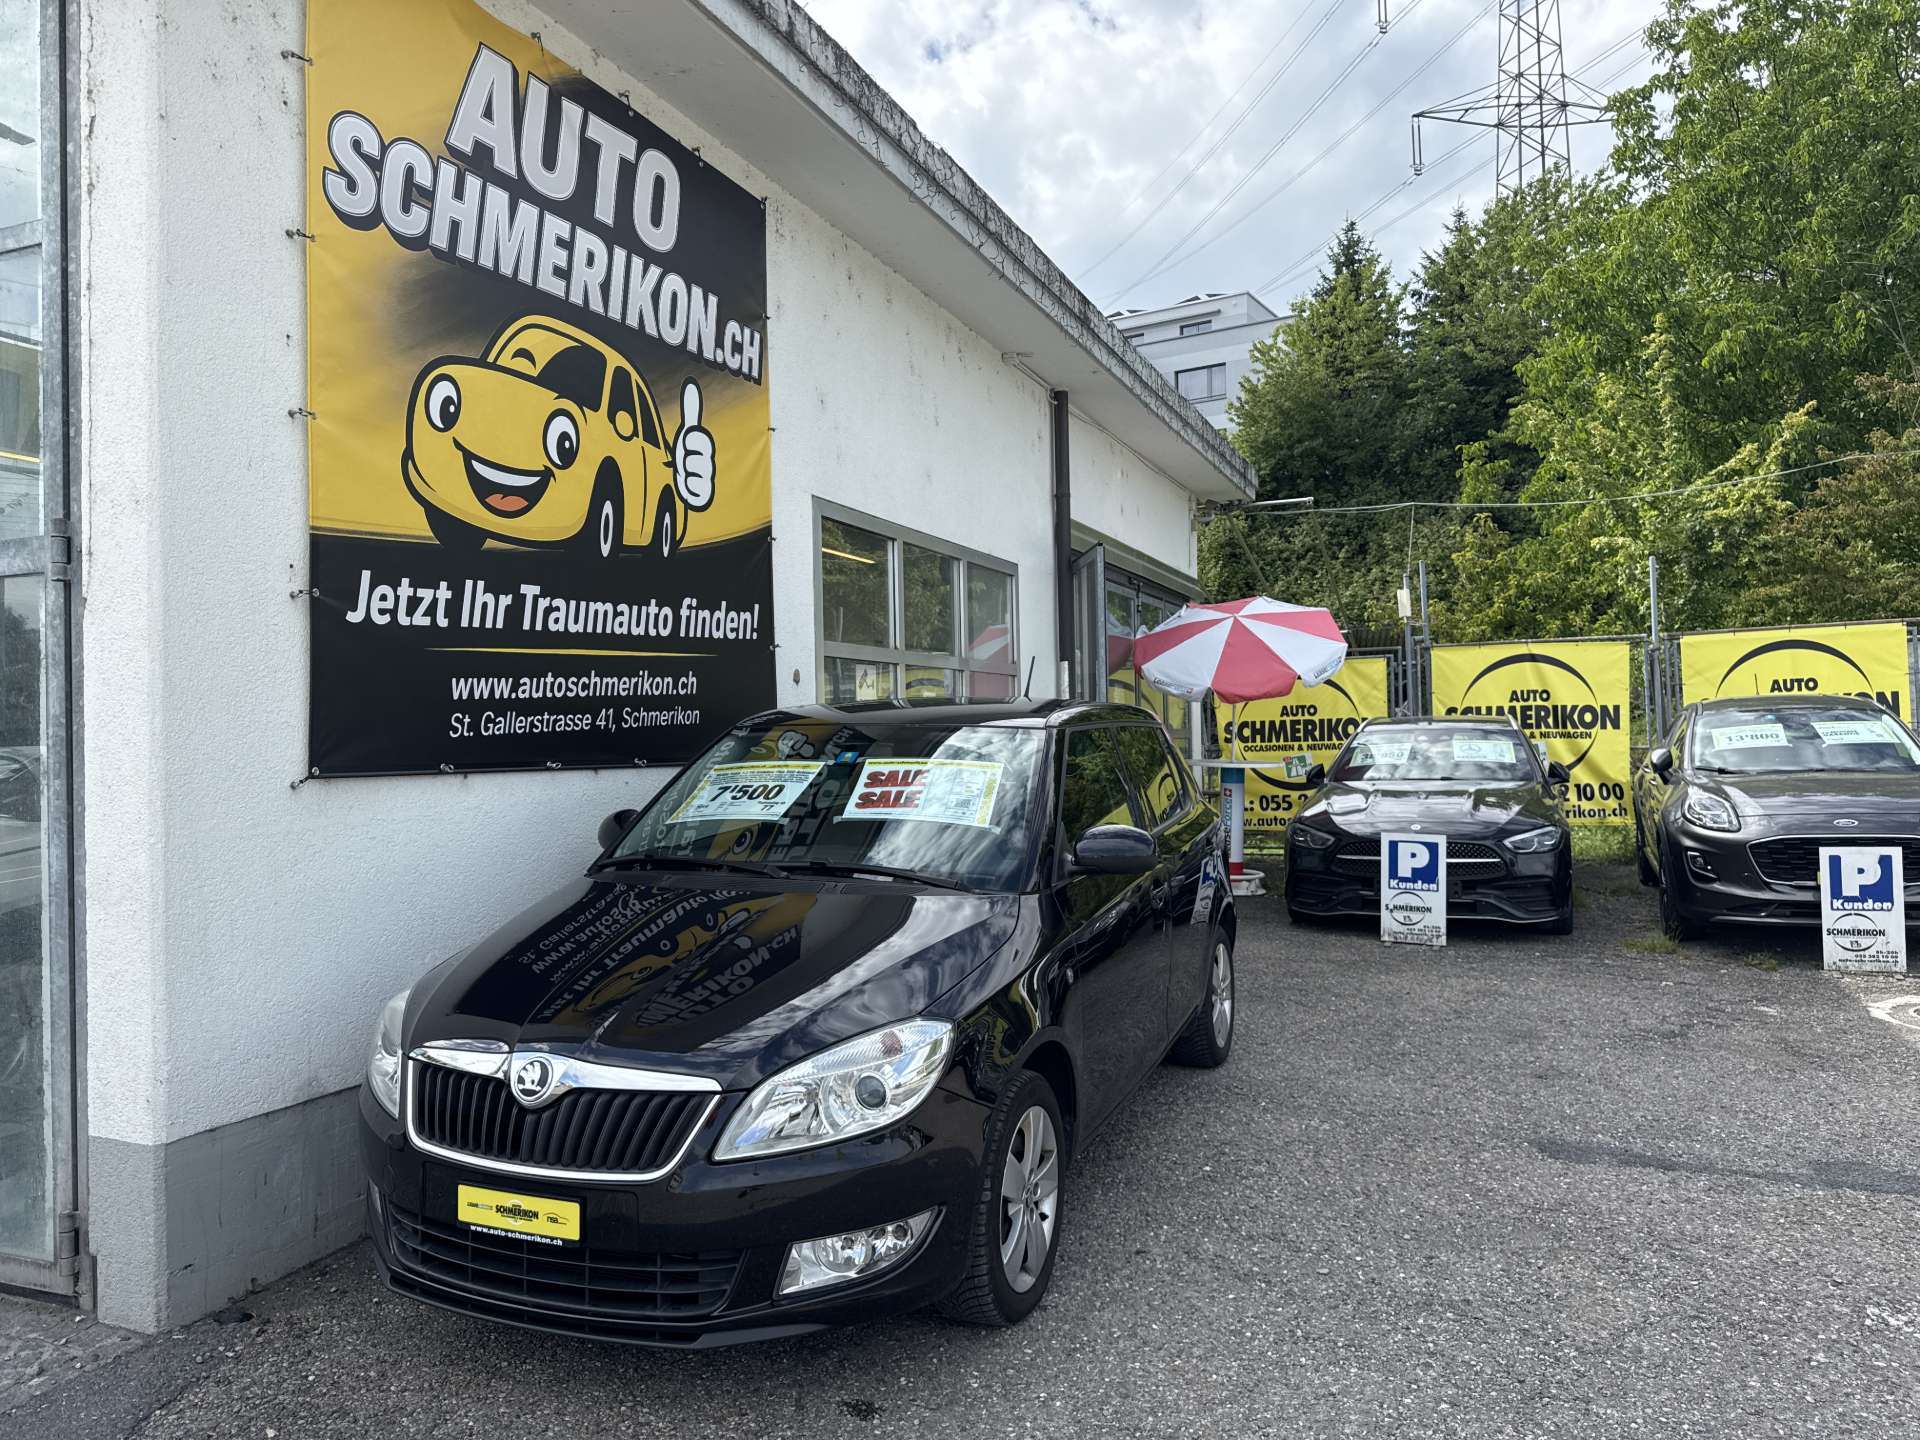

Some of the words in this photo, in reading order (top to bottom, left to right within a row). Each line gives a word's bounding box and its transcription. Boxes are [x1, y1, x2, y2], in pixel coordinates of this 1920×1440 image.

[445, 42, 681, 253] AUTO
[323, 111, 763, 382] SCHMERIKON.CH
[345, 569, 451, 628] Jetzt
[460, 580, 512, 629] Ihr
[519, 584, 673, 637] Traumauto
[679, 597, 760, 640] finden!
[451, 670, 697, 700] www.autoschmerikon.ch
[1770, 677, 1818, 693] AUTO
[1509, 689, 1551, 703] AUTO
[1280, 704, 1318, 717] AUTO
[449, 713, 474, 738] St.
[480, 710, 592, 736] Gallerstrasse
[596, 708, 617, 734] 41,
[621, 707, 700, 731] Schmerikon
[1224, 716, 1368, 744] SCHMERIKO
[1529, 731, 1537, 739] &
[1539, 731, 1592, 739] NEUWAGEN
[1243, 744, 1295, 752] OCCASIONEN
[1306, 743, 1344, 751] NEUWAG
[864, 769, 930, 788] SALE
[710, 784, 786, 802] 7'500
[855, 790, 923, 810] SALE
[1574, 783, 1595, 801] 10
[1598, 782, 1625, 801] 00
[1259, 794, 1293, 812] 055
[1564, 803, 1628, 819] rikon.ch
[1398, 842, 1430, 878] P
[1390, 878, 1438, 891] Kunden
[1841, 855, 1882, 897] P
[1831, 898, 1893, 911] Kunden
[1826, 927, 1886, 937] SCHMERIKON
[495, 1204, 539, 1219] SCHMERIKON
[470, 1225, 563, 1246] www.auto-schmerikon.ch
